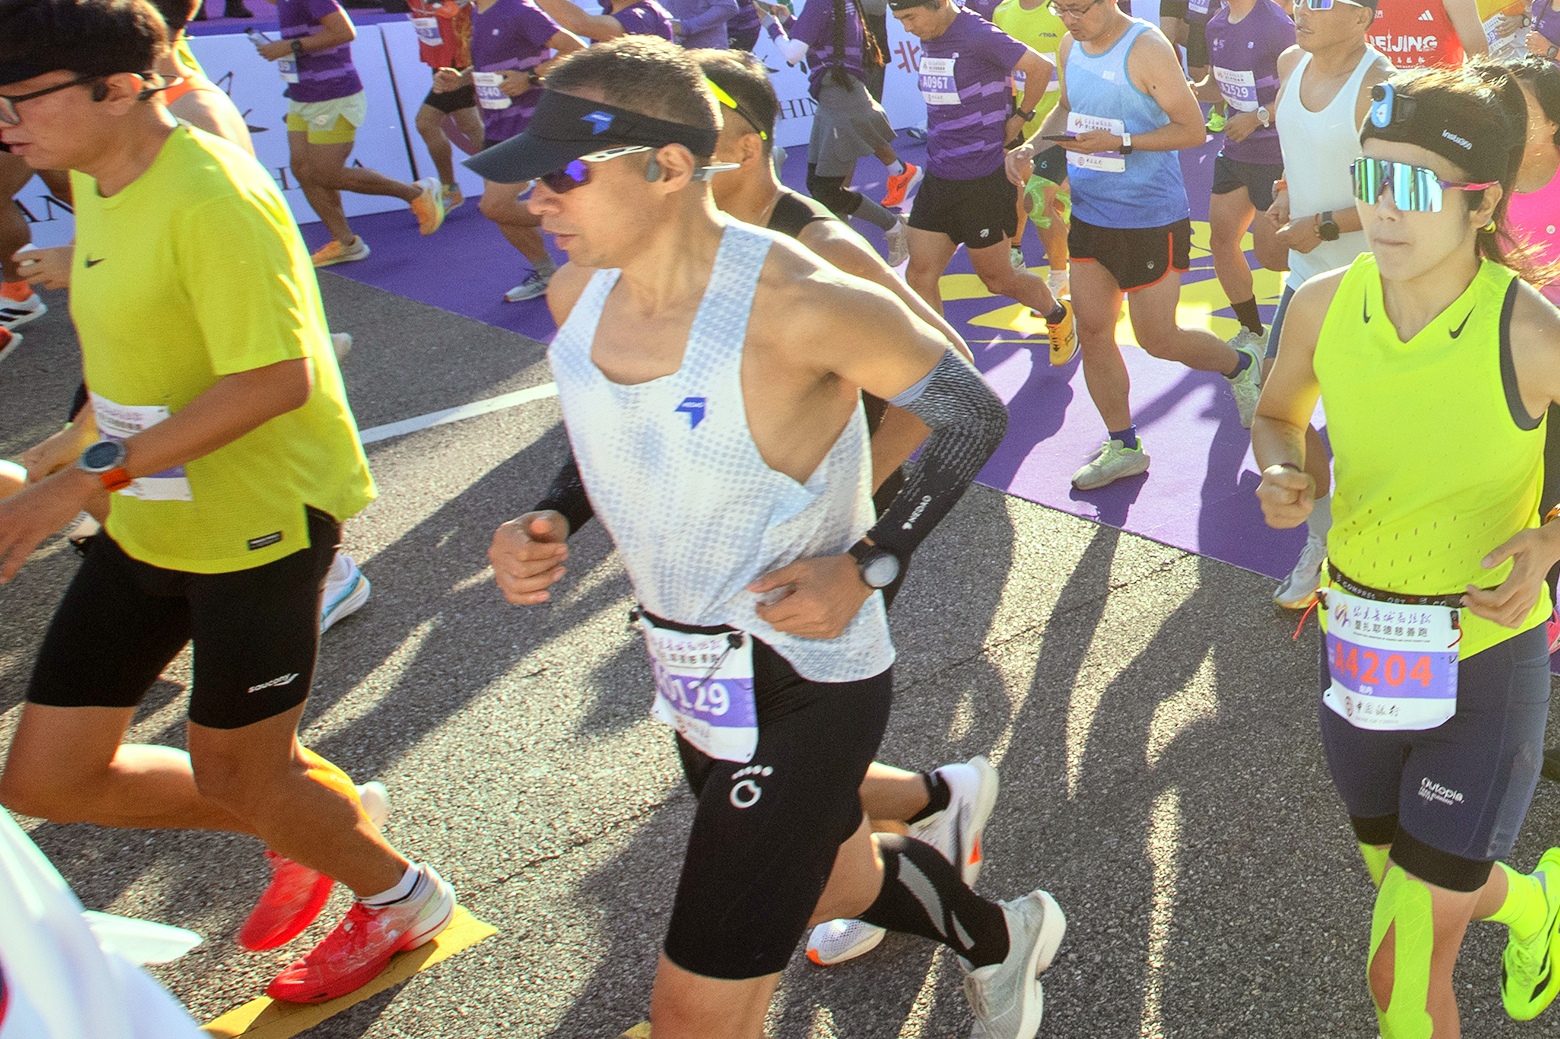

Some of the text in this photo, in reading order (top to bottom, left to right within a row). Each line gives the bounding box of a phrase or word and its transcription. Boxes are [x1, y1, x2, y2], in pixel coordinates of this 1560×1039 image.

[922, 75, 949, 90] A0967
[1333, 641, 1434, 688] A4204
[248, 673, 292, 694] saucony
